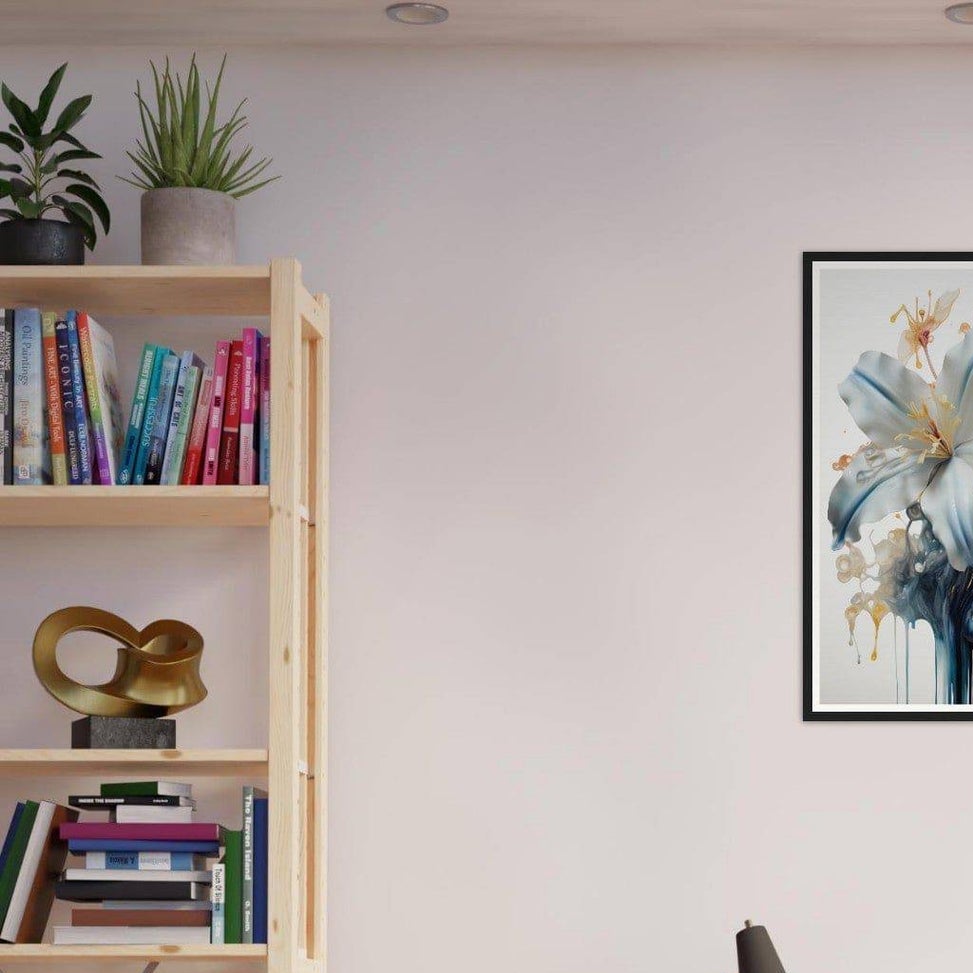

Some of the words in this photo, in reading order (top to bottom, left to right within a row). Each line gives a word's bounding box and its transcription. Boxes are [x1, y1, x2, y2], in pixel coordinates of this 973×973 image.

[22, 325, 32, 340] Oil
[80, 327, 92, 373] Watercolor
[18, 342, 32, 386] Paintings
[59, 344, 74, 409] ICONIC
[231, 363, 241, 397] Parenting
[244, 850, 252, 881] Island
